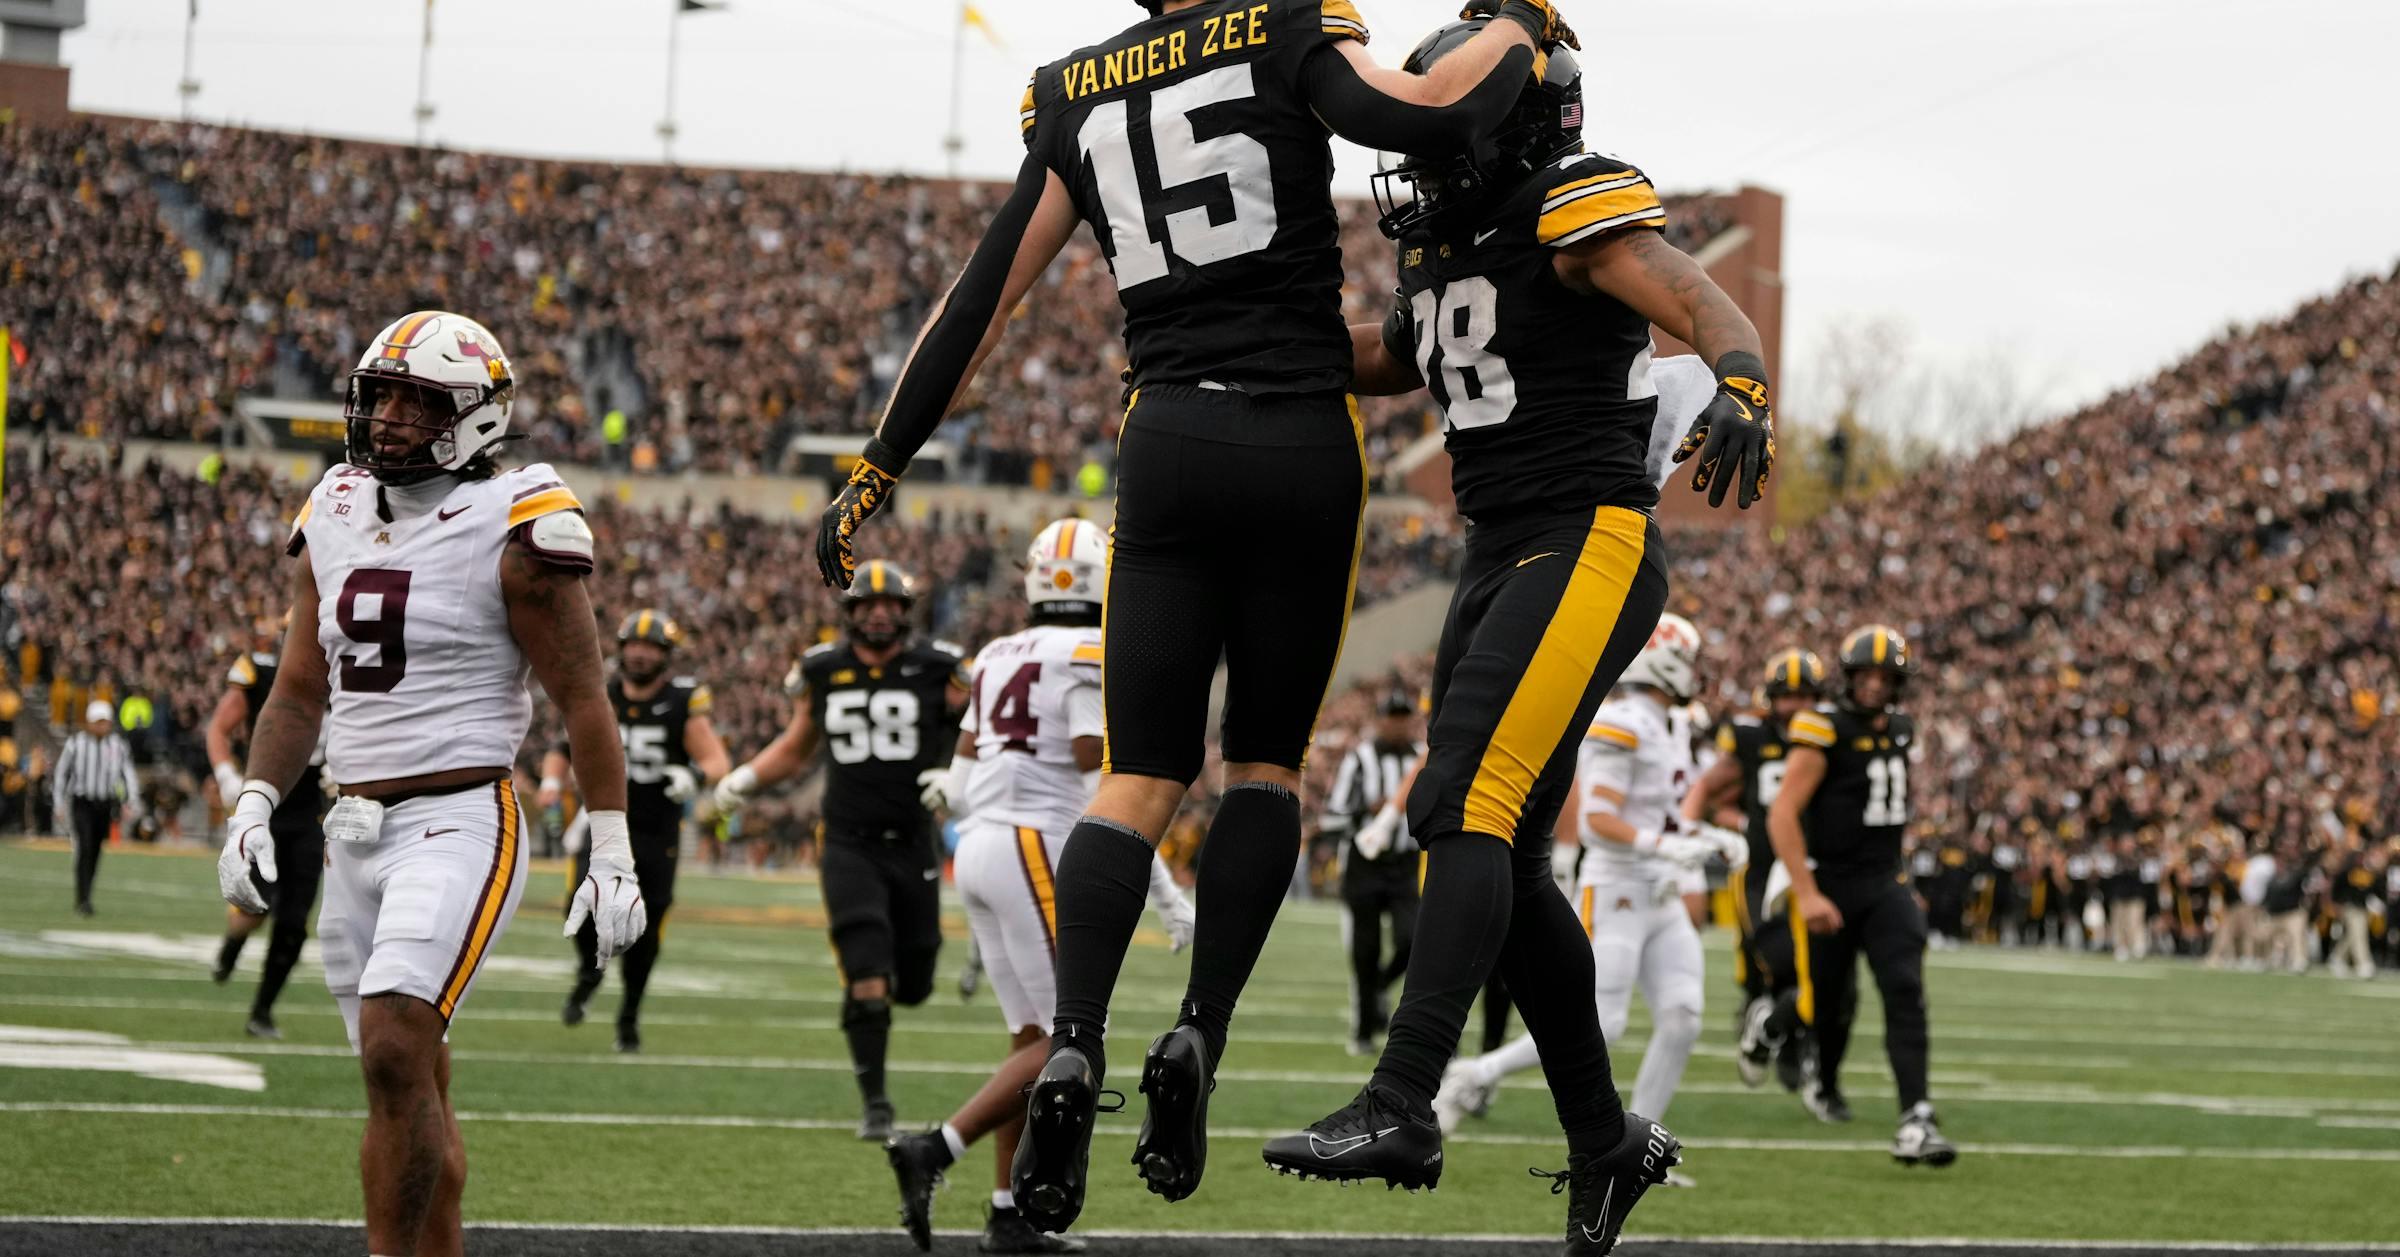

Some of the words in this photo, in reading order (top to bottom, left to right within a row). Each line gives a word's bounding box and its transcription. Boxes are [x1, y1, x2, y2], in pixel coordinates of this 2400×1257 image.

[1062, 29, 1187, 101] VANDER
[1201, 3, 1269, 58] ZEE
[1077, 62, 1278, 291] 15
[336, 568, 412, 693] 9
[825, 690, 919, 764] 58
[972, 662, 1042, 757] 14
[619, 724, 668, 785] 5
[1862, 756, 1907, 827] 11
[1629, 1123, 1669, 1197] VAPOR
